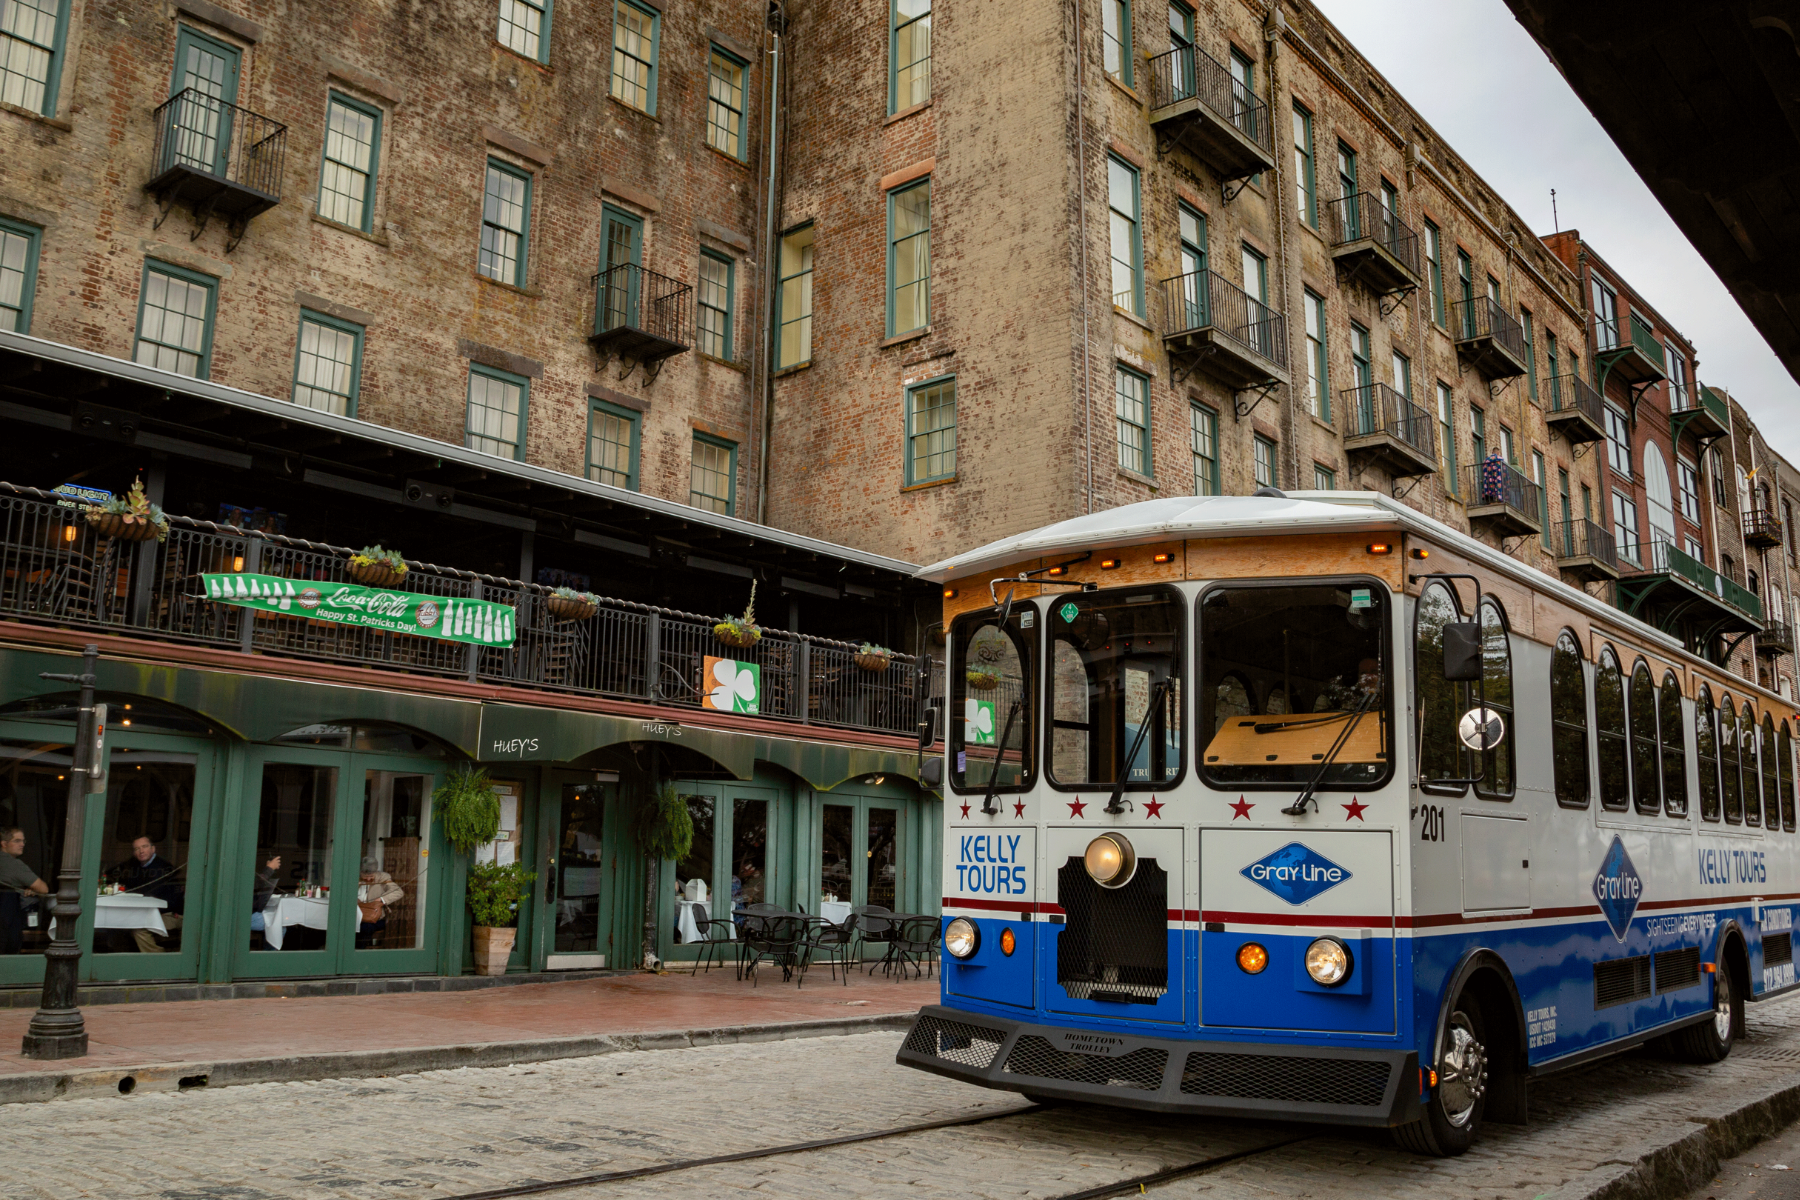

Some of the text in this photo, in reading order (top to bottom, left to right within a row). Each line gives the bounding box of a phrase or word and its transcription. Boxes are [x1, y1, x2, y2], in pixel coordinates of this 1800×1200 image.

[57, 500, 76, 508] RIVER
[77, 489, 109, 501] LIGHT
[326, 587, 410, 618] Coca-Cola
[316, 608, 417, 632] Happy St. Patricks Day!
[642, 723, 682, 739] HUEY'S
[493, 738, 539, 758] HUEY'S
[1421, 804, 1445, 842] 201
[961, 835, 1021, 863] KELLY
[1251, 864, 1342, 882] Gray Line
[1698, 849, 1767, 884] KELLY TOURS
[956, 865, 1026, 894] TOURS
[1597, 872, 1639, 900] Gray Line
[1064, 1033, 1125, 1046] HOMETOWN
[1070, 1043, 1112, 1053] TROLLEY
